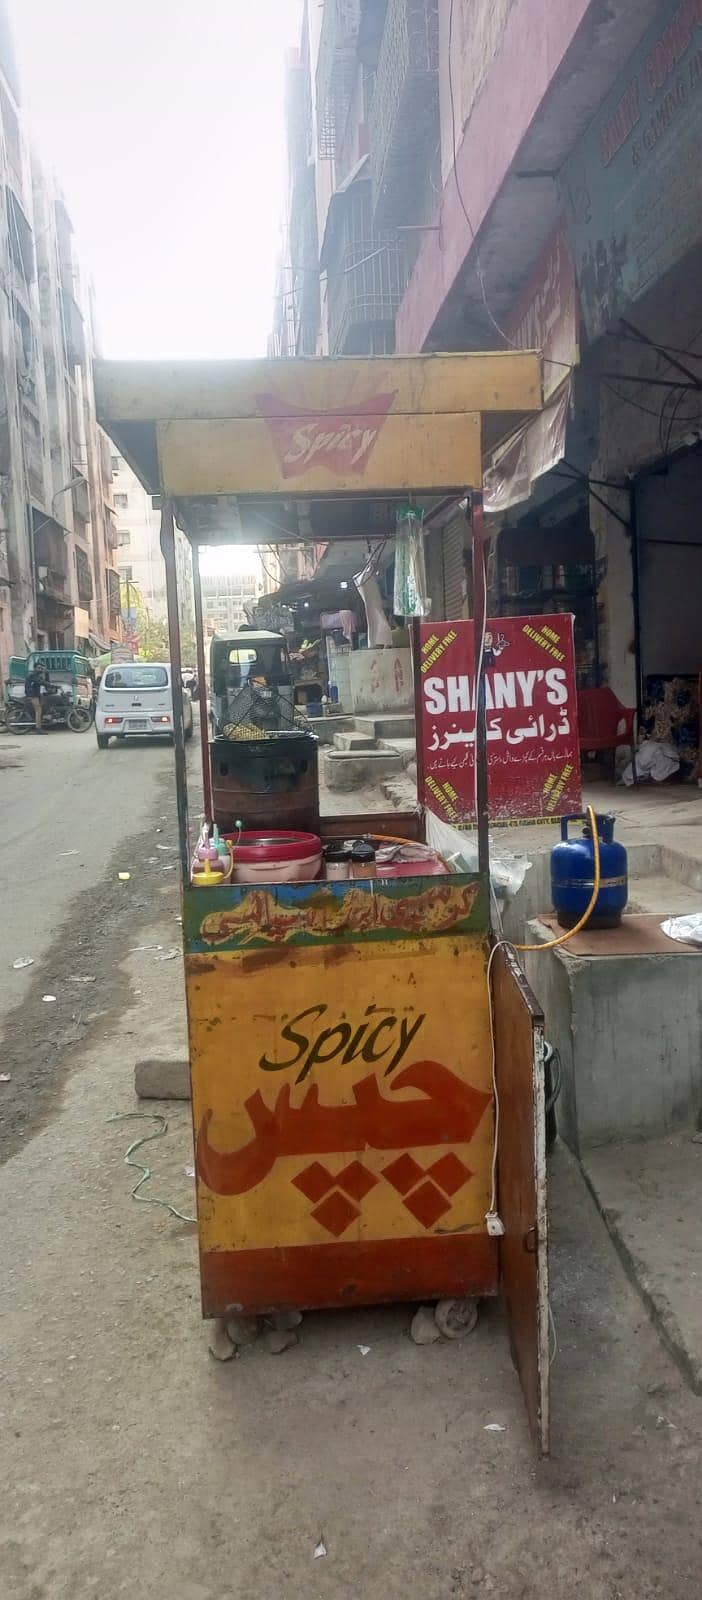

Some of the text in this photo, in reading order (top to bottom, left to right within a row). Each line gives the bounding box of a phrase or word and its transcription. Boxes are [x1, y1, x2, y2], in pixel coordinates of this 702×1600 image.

[284, 423, 377, 464] Spicy
[421, 635, 439, 654] HOME
[421, 630, 457, 673] DELIVERY FREE
[522, 624, 565, 662] DELIVERY FREE
[541, 625, 560, 643] HOME
[423, 667, 568, 715] SHANY'S
[427, 707, 570, 751] ڈرائی کینرز
[442, 782, 458, 801] HOME
[543, 773, 557, 800] HOME
[560, 764, 574, 781] FREE
[425, 775, 457, 819] DELIVERY FREE
[258, 1003, 426, 1085] Spicy
[196, 1060, 494, 1238] چپس
